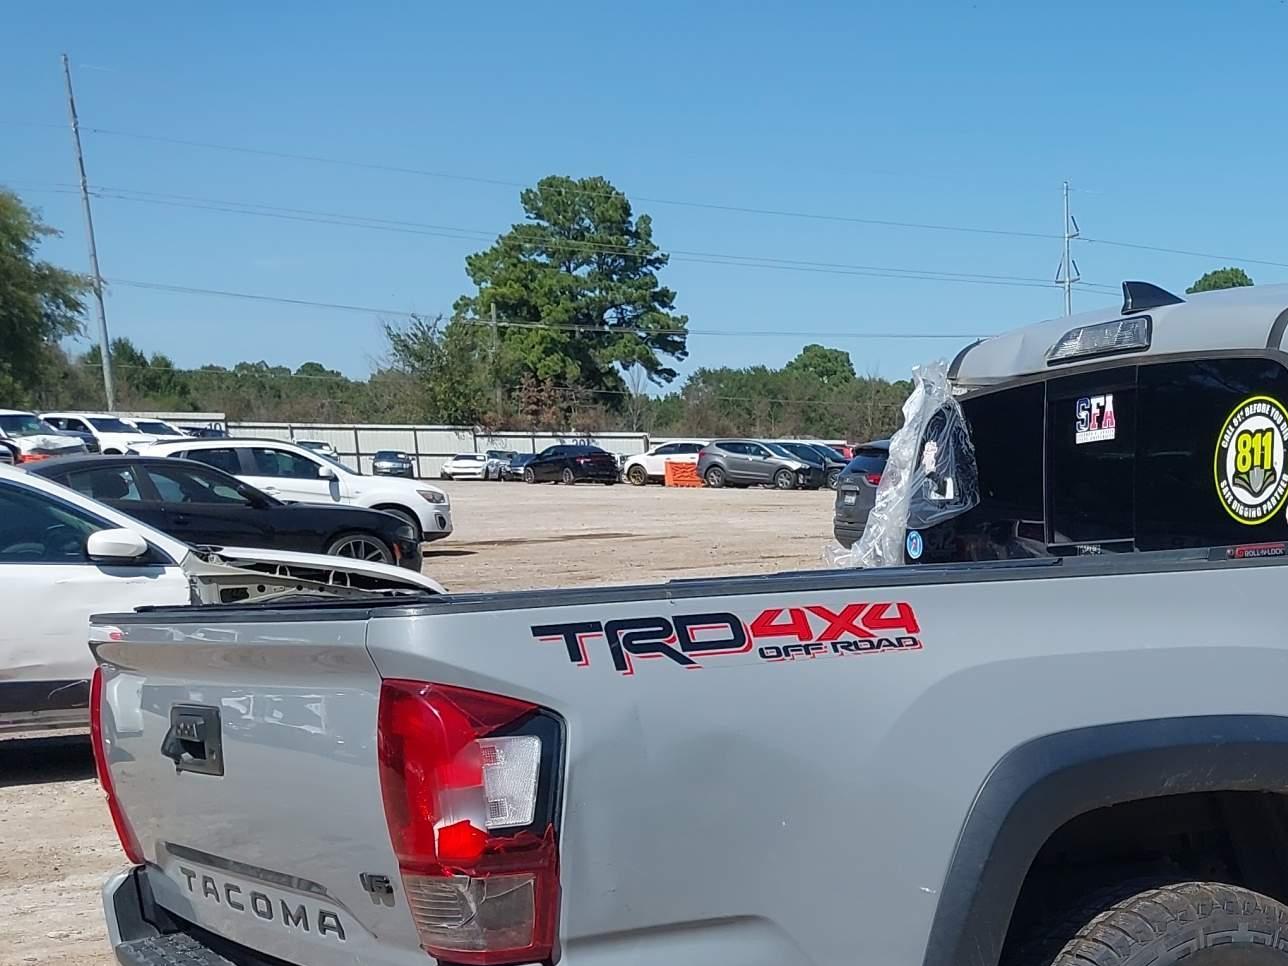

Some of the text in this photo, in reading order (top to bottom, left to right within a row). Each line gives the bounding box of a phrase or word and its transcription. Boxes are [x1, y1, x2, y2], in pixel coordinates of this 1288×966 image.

[1076, 395, 1116, 433] SFA
[1221, 424, 1235, 449] CALL
[1244, 403, 1271, 417] BEFORE
[1270, 404, 1284, 425] YOU
[1236, 429, 1274, 473] 811
[1220, 480, 1234, 505] SAFE
[1231, 500, 1262, 518] DIGGING
[530, 602, 921, 676] TRD 4X4
[758, 636, 923, 662] OFF ROAD
[179, 866, 347, 942] TACOMA
